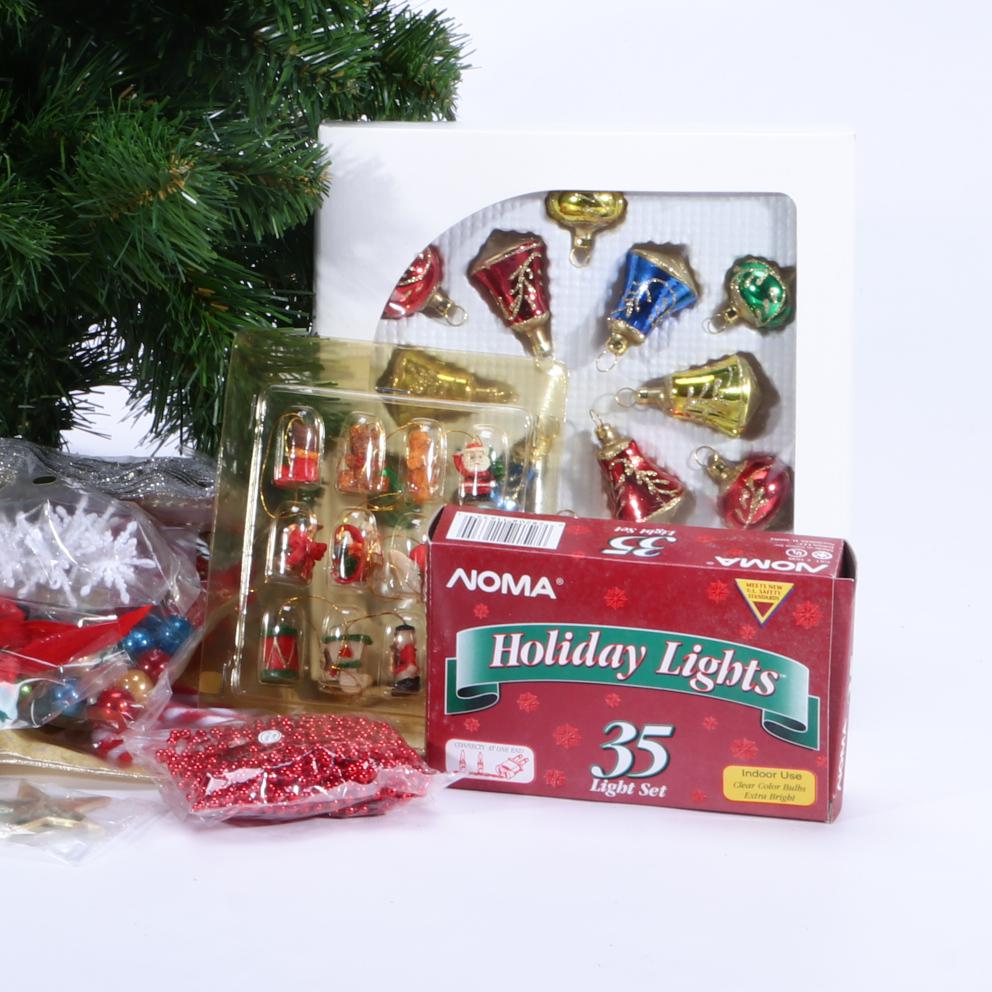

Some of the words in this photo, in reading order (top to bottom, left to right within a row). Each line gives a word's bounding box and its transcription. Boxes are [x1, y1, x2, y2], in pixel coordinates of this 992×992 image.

[602, 536, 678, 558] 35
[489, 629, 647, 679] Holiday
[591, 720, 676, 780] 35
[742, 769, 776, 779] Indoor
[781, 771, 802, 780] Use
[591, 779, 636, 798] Light
[639, 782, 667, 798] Set
[733, 781, 755, 789] Clear
[744, 792, 767, 800] Extra
[769, 794, 795, 802] Bright
